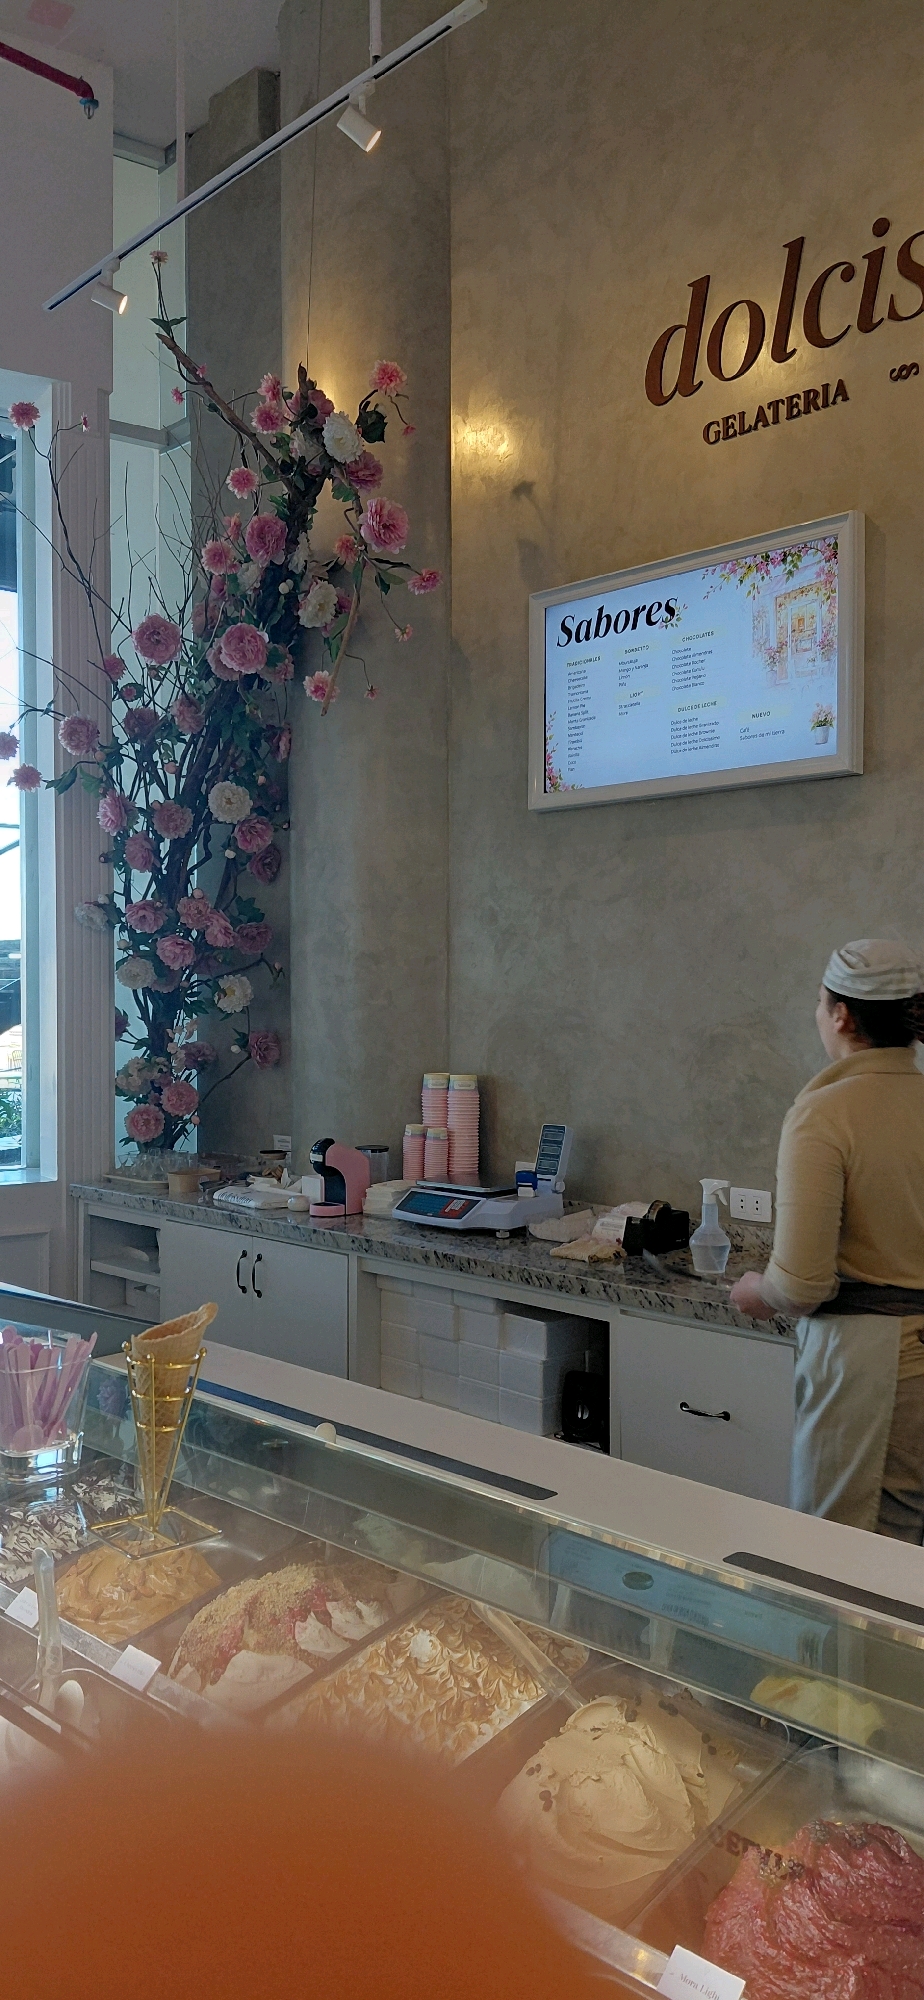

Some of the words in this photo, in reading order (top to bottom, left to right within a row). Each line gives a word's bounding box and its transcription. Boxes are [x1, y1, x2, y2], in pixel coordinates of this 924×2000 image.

[645, 217, 924, 406] dolcis
[702, 378, 850, 445] GELATERIA
[556, 597, 679, 648] Sabores
[681, 630, 715, 643] CHOCOLATES
[677, 704, 693, 713] DULCE
[701, 700, 718, 709] LECHE
[751, 710, 771, 719] NUEVO
